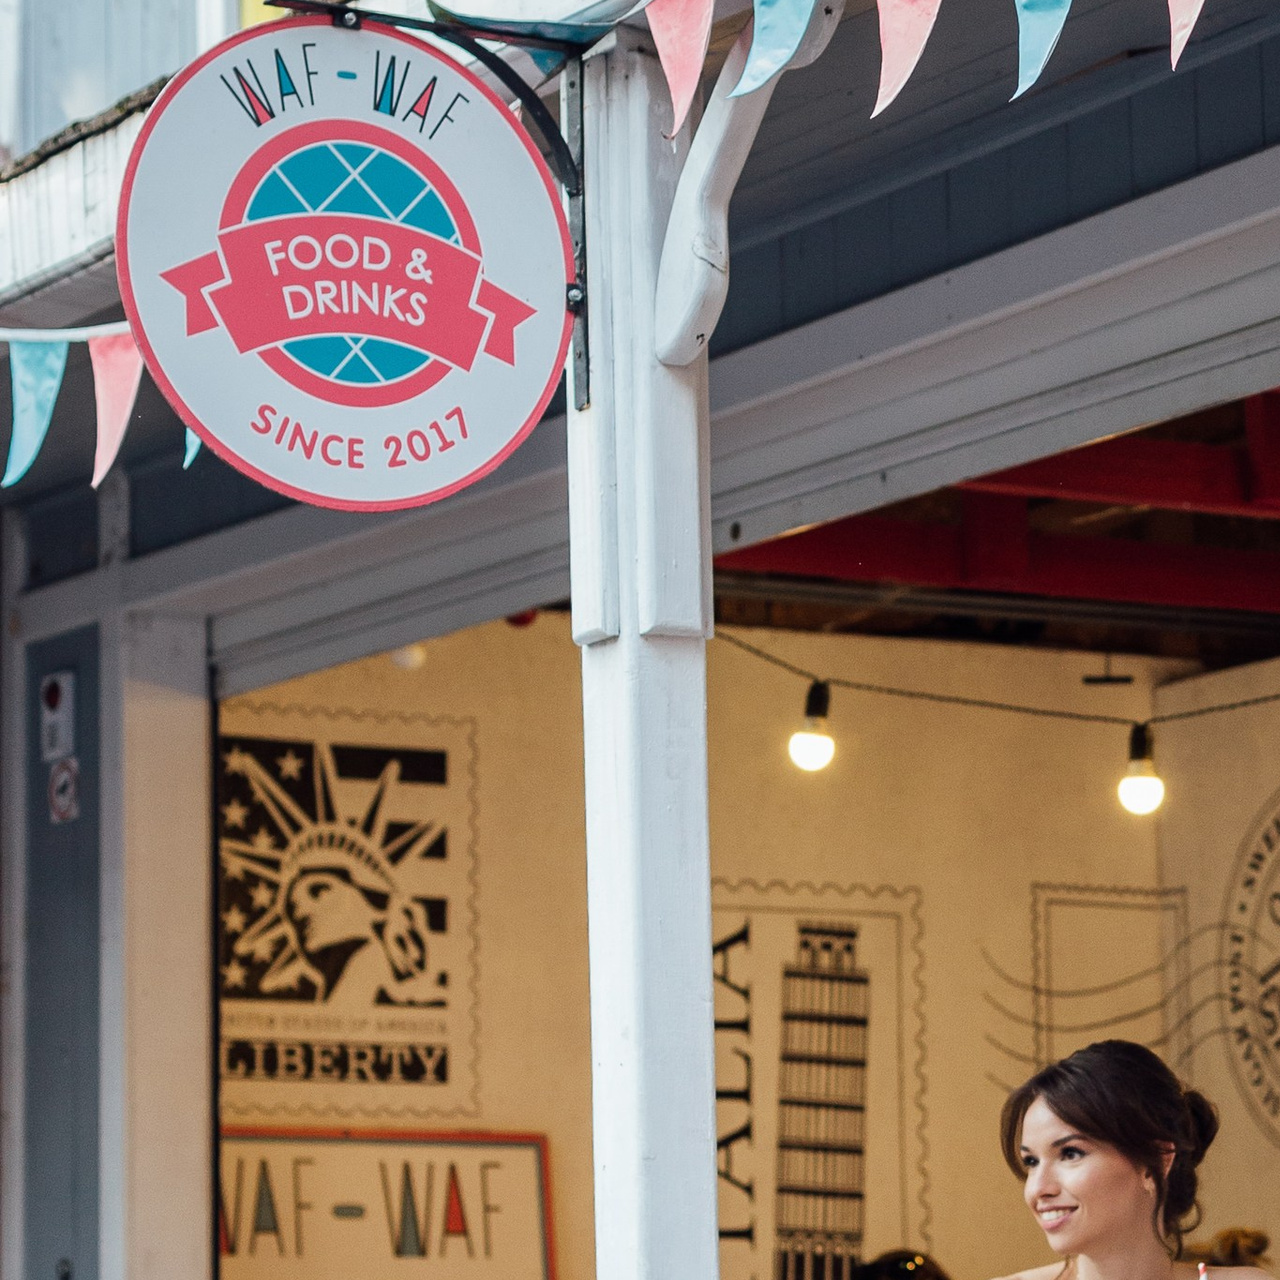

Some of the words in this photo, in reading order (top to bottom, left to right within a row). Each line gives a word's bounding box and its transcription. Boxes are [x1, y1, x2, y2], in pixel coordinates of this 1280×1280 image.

[264, 233, 391, 276] FOOD
[404, 248, 433, 284] &
[283, 283, 427, 326] DRINKS
[250, 403, 365, 468] SINCE
[383, 406, 470, 468] 2017
[221, 1041, 445, 1081] LIBERTY
